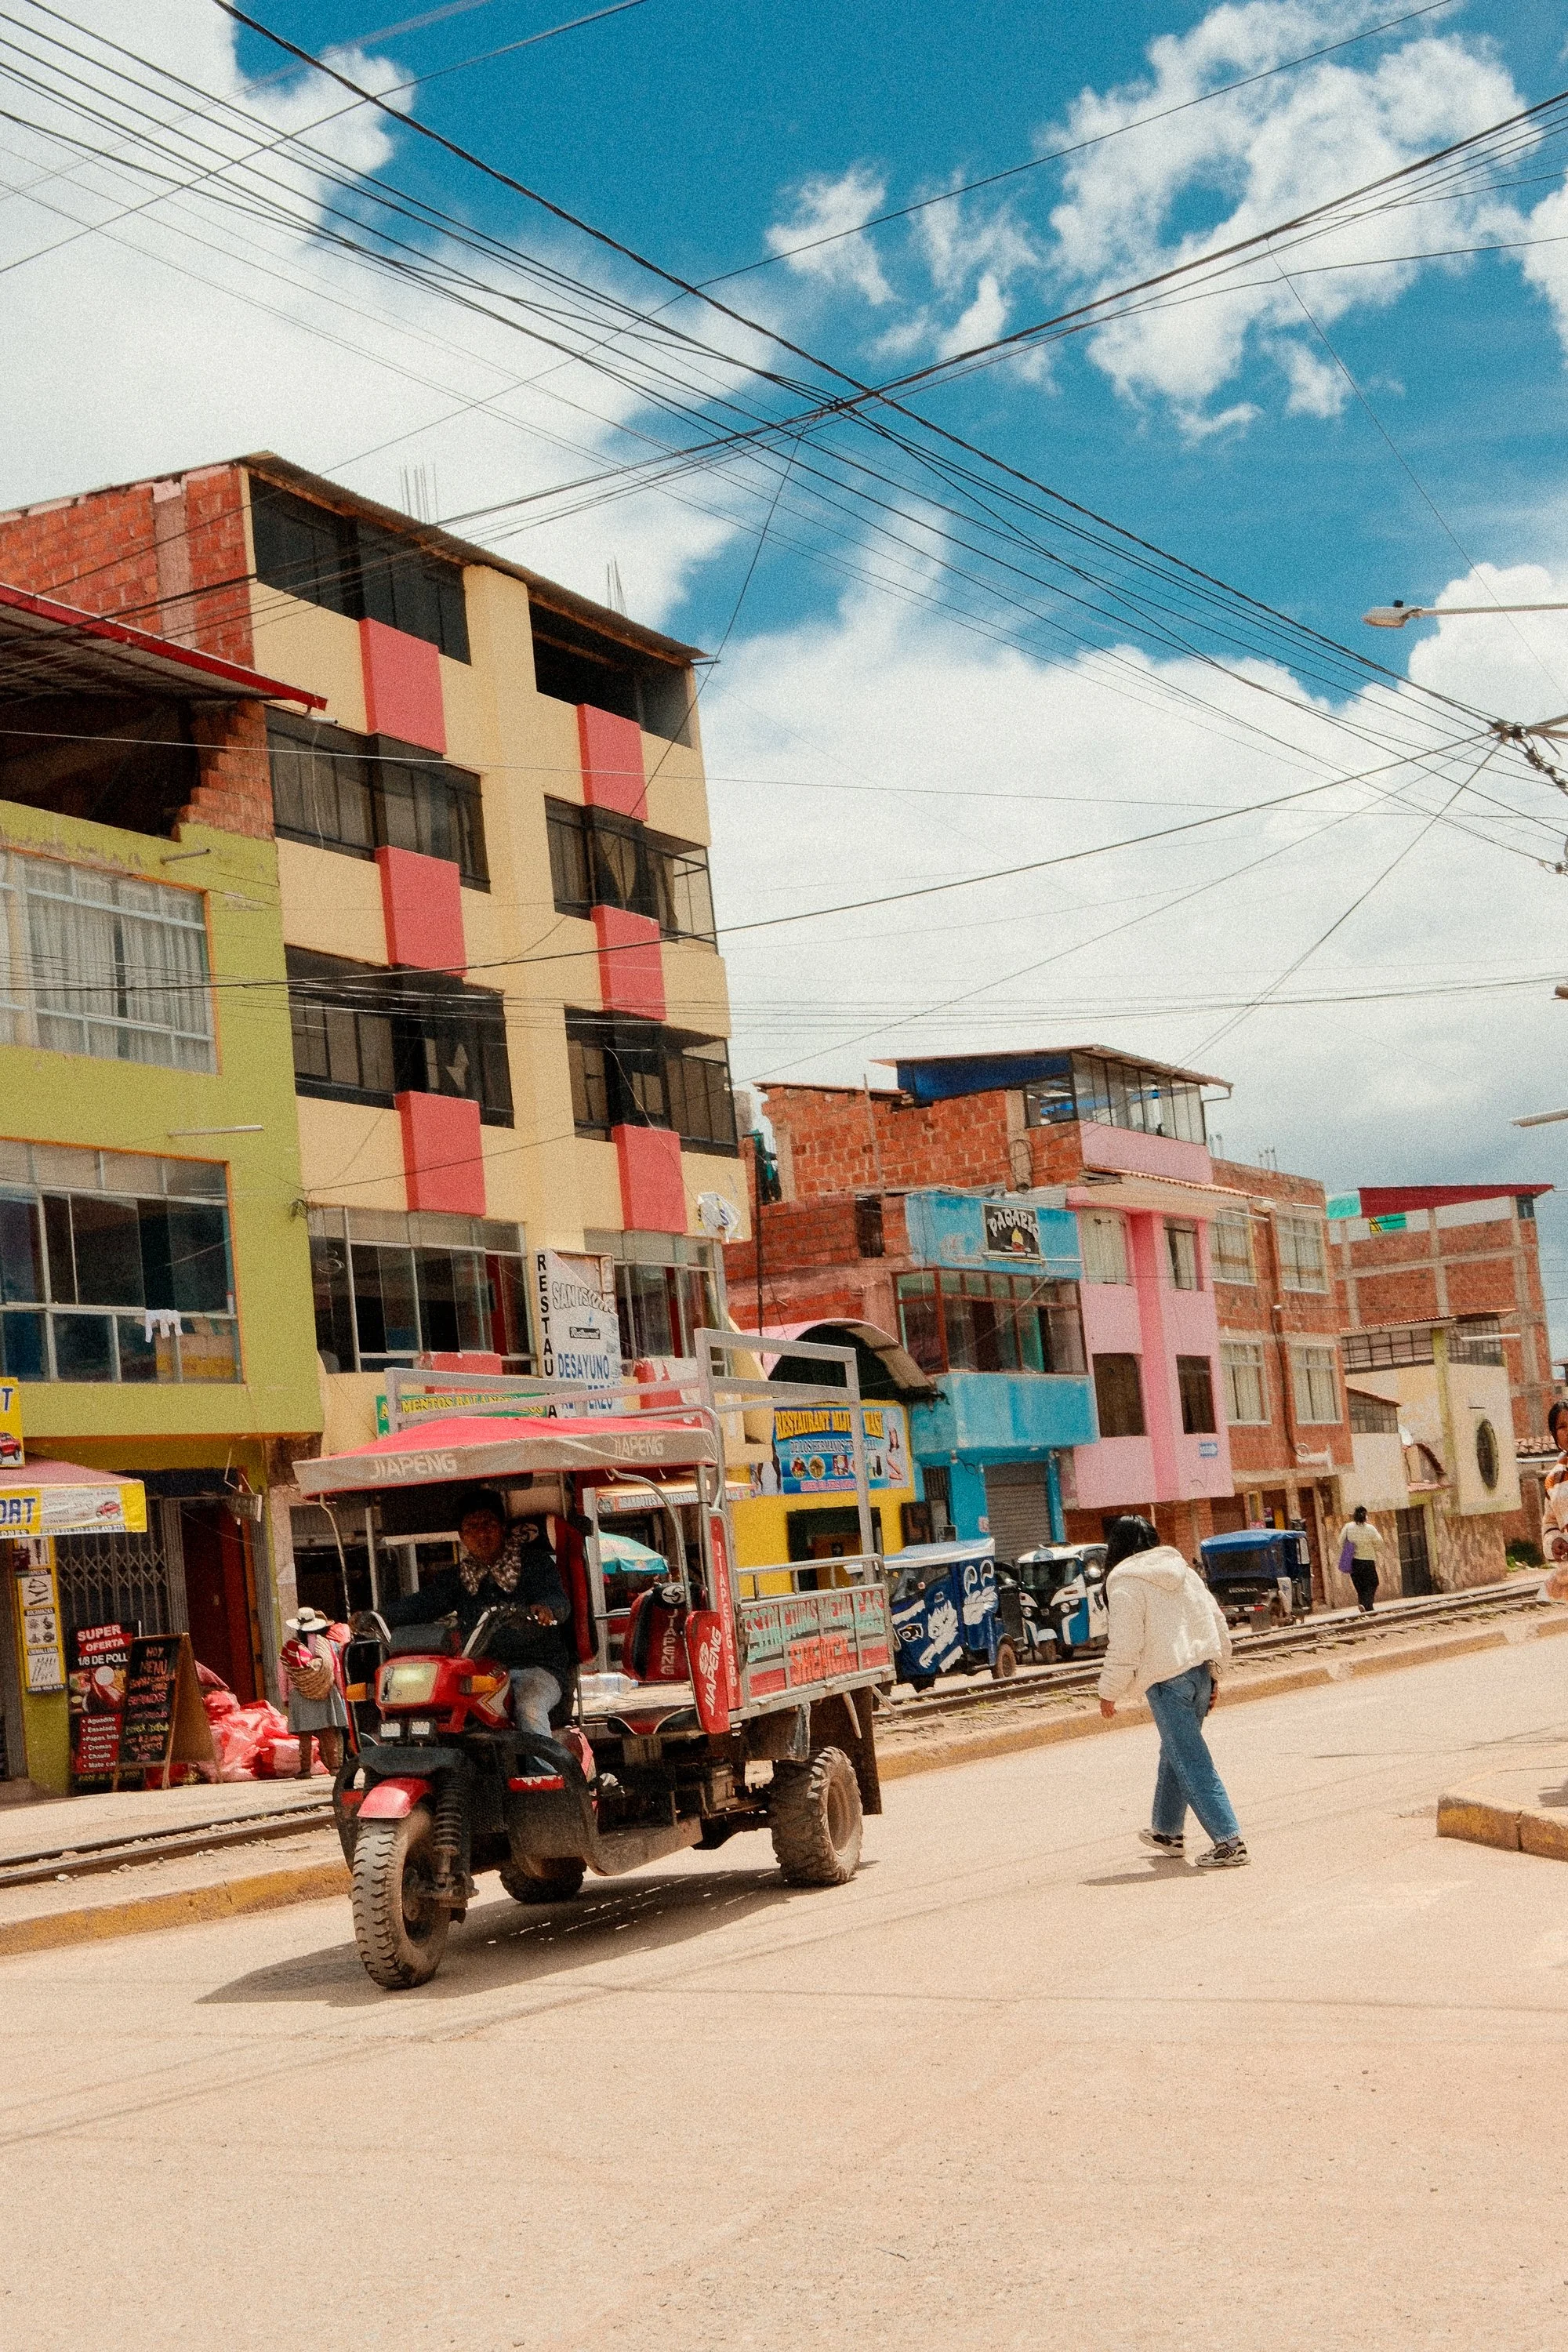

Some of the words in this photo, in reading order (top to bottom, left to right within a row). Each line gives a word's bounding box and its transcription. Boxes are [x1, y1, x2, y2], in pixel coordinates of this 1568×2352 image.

[558, 1352, 610, 1380] DESAYUNO
[380, 1396, 453, 1420] AMENTOS
[613, 1436, 664, 1457] JIAPENG
[369, 1454, 458, 1481] JIAPENG
[716, 1541, 734, 1650] JIAPENG
[727, 1654, 738, 1688] 300
[77, 1624, 122, 1642] SUPER
[85, 1637, 125, 1653] OFERTA
[660, 1607, 679, 1676] JIAPENG
[78, 1655, 90, 1667] 1/8
[91, 1654, 104, 1665] DE
[703, 1625, 723, 1716] JIAPENG
